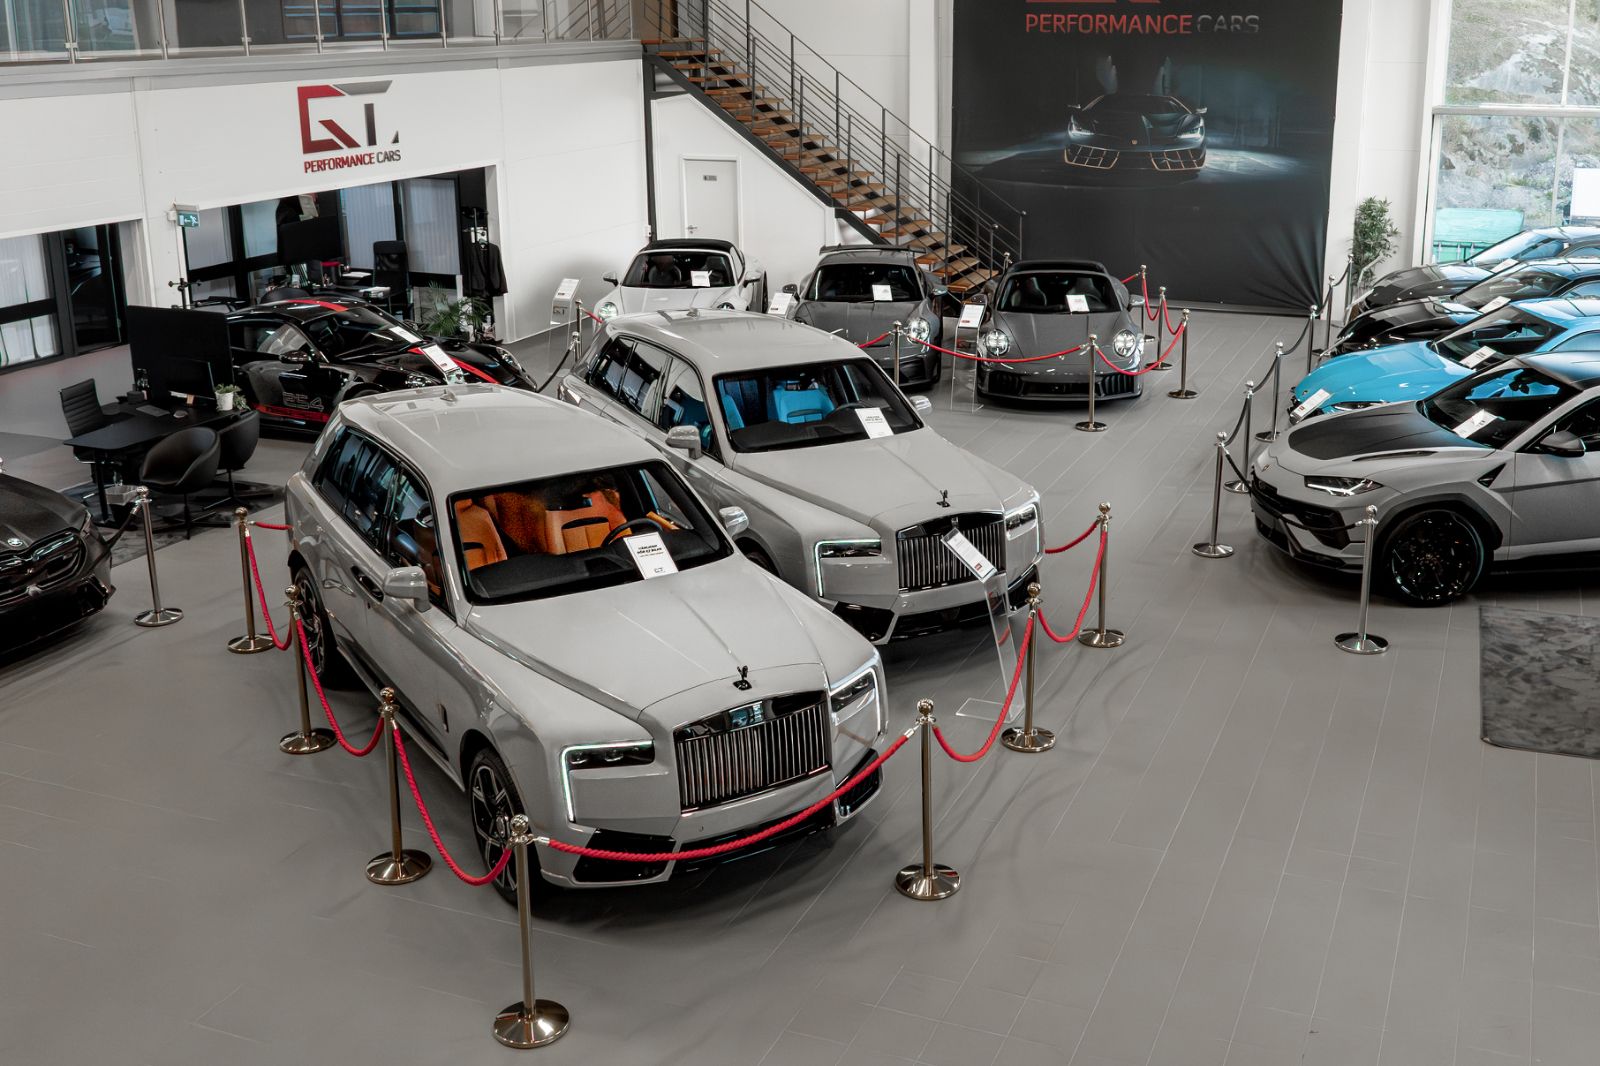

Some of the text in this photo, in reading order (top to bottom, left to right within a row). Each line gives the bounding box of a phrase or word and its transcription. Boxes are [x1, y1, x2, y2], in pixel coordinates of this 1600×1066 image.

[1025, 13, 1260, 34] PERFORMANCE CARS
[304, 149, 401, 173] PERFORMANCE CARS
